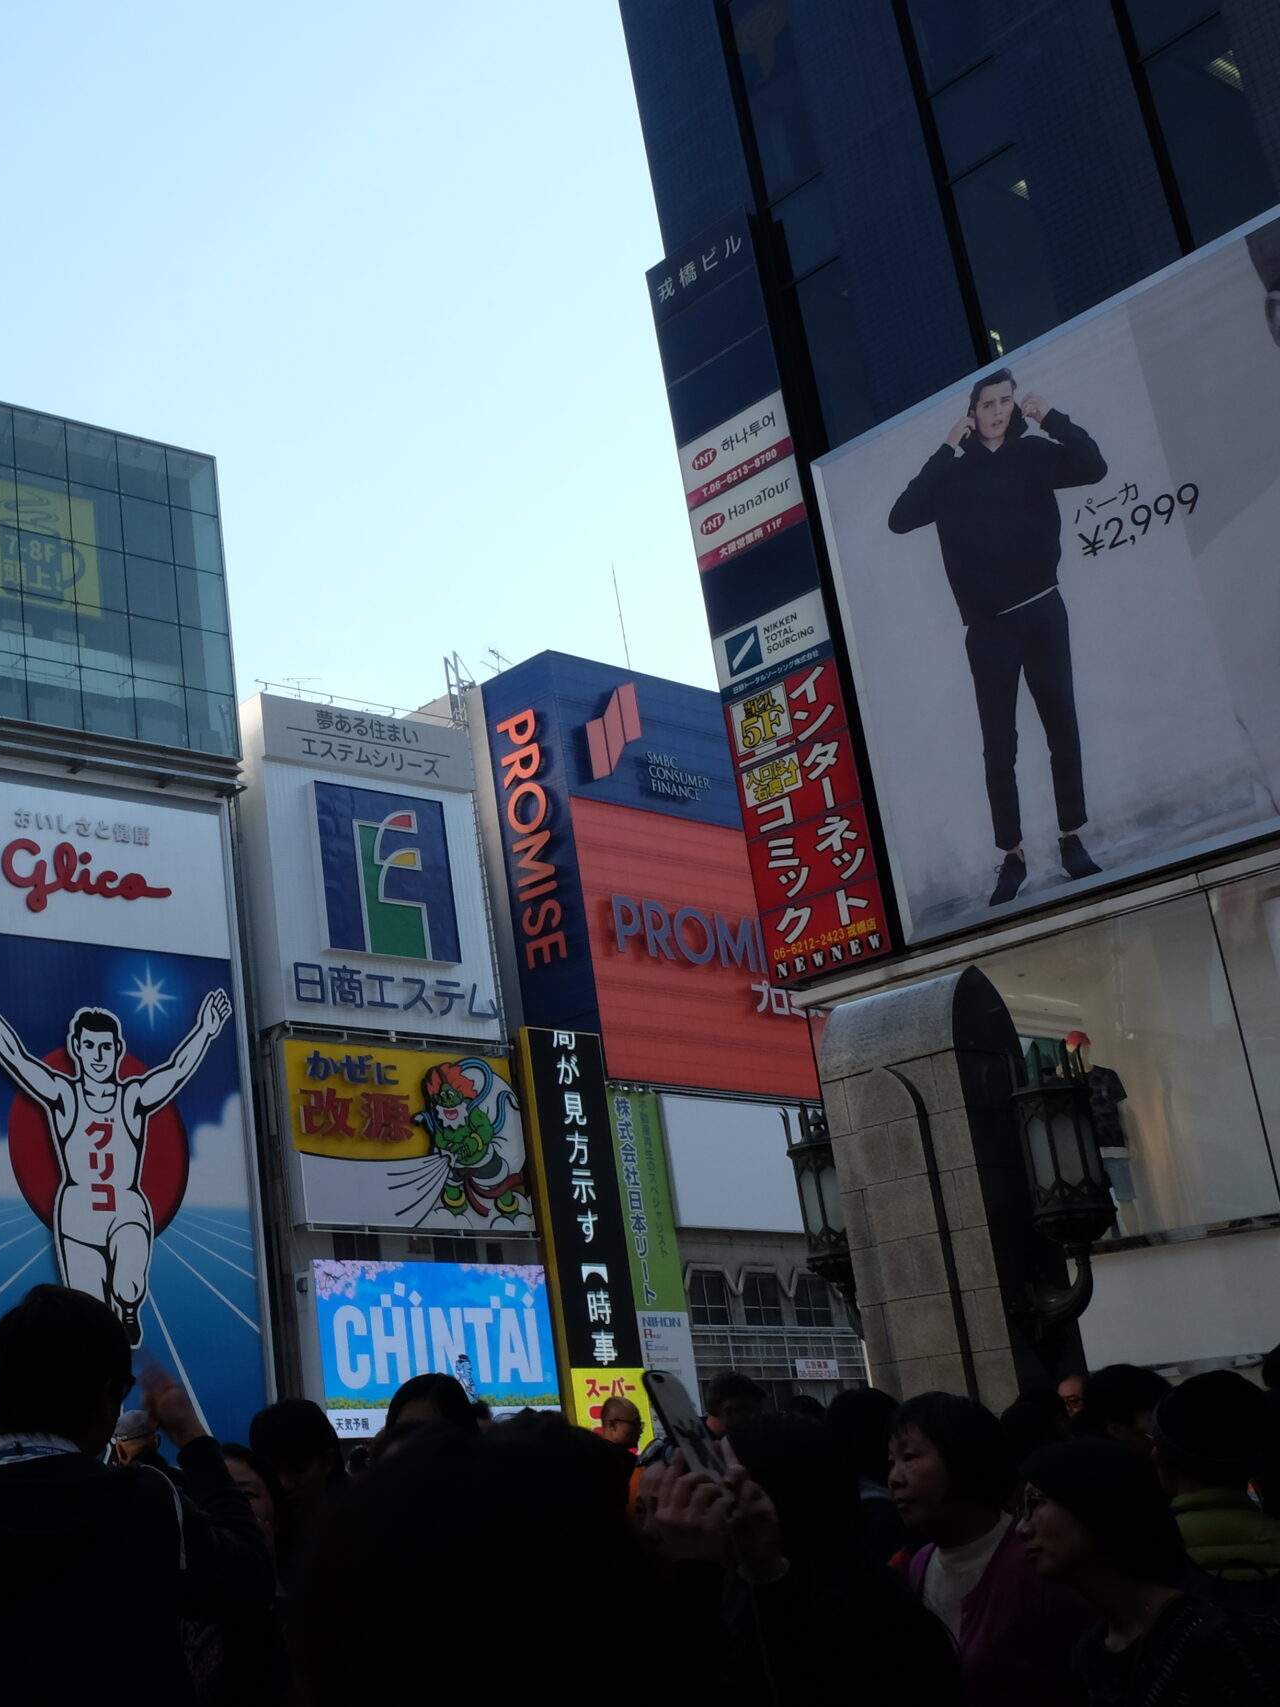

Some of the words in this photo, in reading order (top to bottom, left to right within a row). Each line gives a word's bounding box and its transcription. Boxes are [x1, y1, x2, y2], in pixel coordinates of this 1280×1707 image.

[657, 234, 743, 303] 戎橋ビル
[721, 412, 776, 452] 하나투어
[728, 478, 791, 520] HanaTour
[1074, 482, 1139, 524] パーカ
[1078, 483, 1199, 557] ¥2,999
[763, 612, 797, 635] NIKKEN
[765, 625, 794, 644] TOTAL
[767, 626, 815, 654] SOURCING
[315, 709, 418, 744] 夢ある住まい
[741, 704, 785, 748] 5F
[302, 737, 440, 779] エステムシリーズ
[646, 751, 679, 769] SMBC
[648, 765, 712, 790] CONSUMER
[746, 759, 788, 789] 入口は
[651, 779, 701, 801] FINANCE
[788, 665, 870, 928] インターネット
[14, 808, 151, 847] おいしさと健康
[496, 708, 567, 969] PROMISE
[1, 838, 172, 913] Glico
[756, 796, 813, 945] コミック
[294, 962, 497, 1019] 日商エステム
[304, 1050, 400, 1086] かぜに
[297, 1088, 414, 1142] 改源
[85, 1117, 116, 1212] グリコ
[614, 1096, 657, 1306] 株式会社日本リート
[333, 1286, 544, 1389] CHINTAI
[642, 1316, 681, 1328] NIHON
[585, 1377, 636, 1397] スーパー
[335, 1417, 370, 1431] 天気予報
